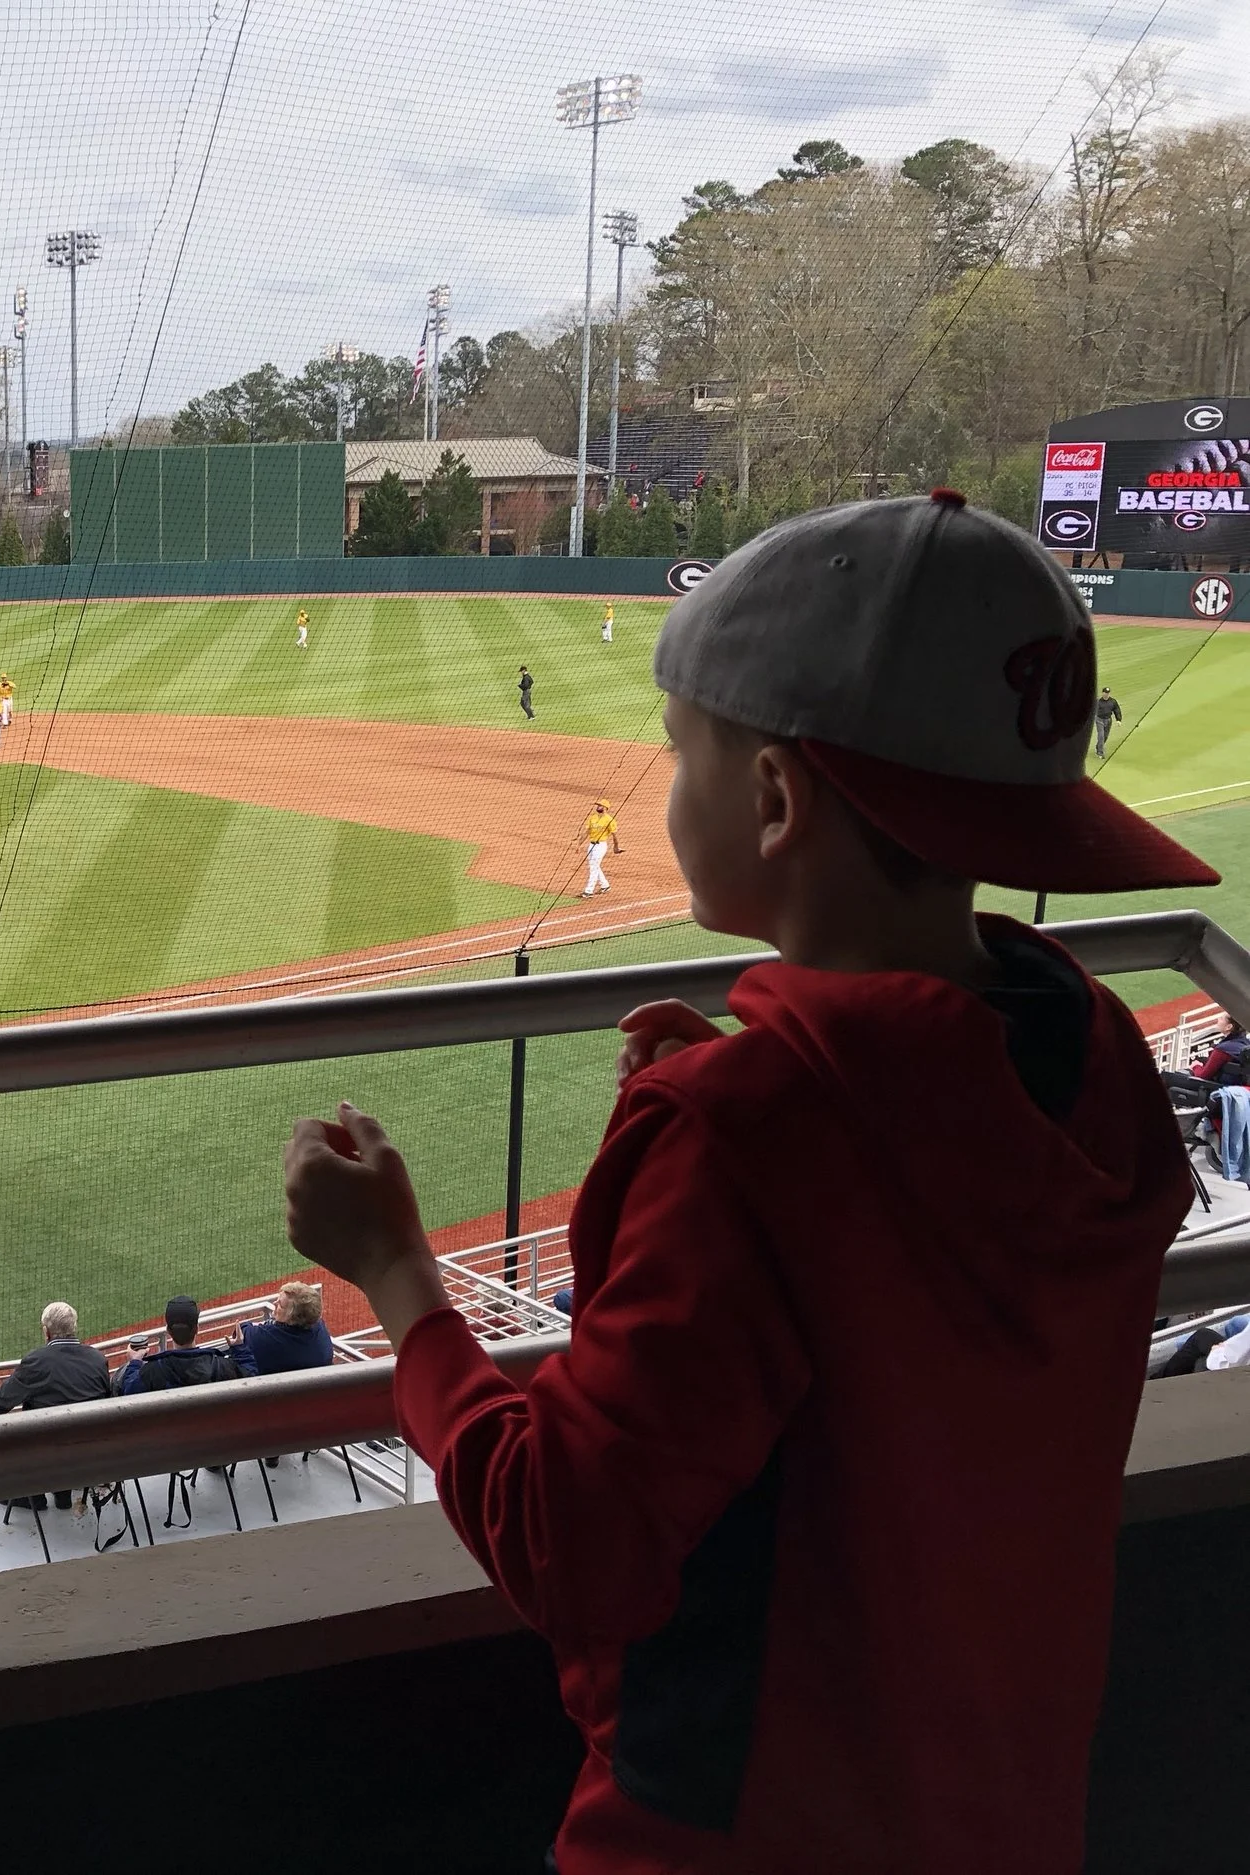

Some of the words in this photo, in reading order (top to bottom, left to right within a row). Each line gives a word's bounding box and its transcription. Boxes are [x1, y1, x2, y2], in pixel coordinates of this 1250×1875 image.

[1147, 472, 1241, 487] GEORGIA
[1078, 587, 1094, 597] 954
[1194, 578, 1230, 616] SEC
